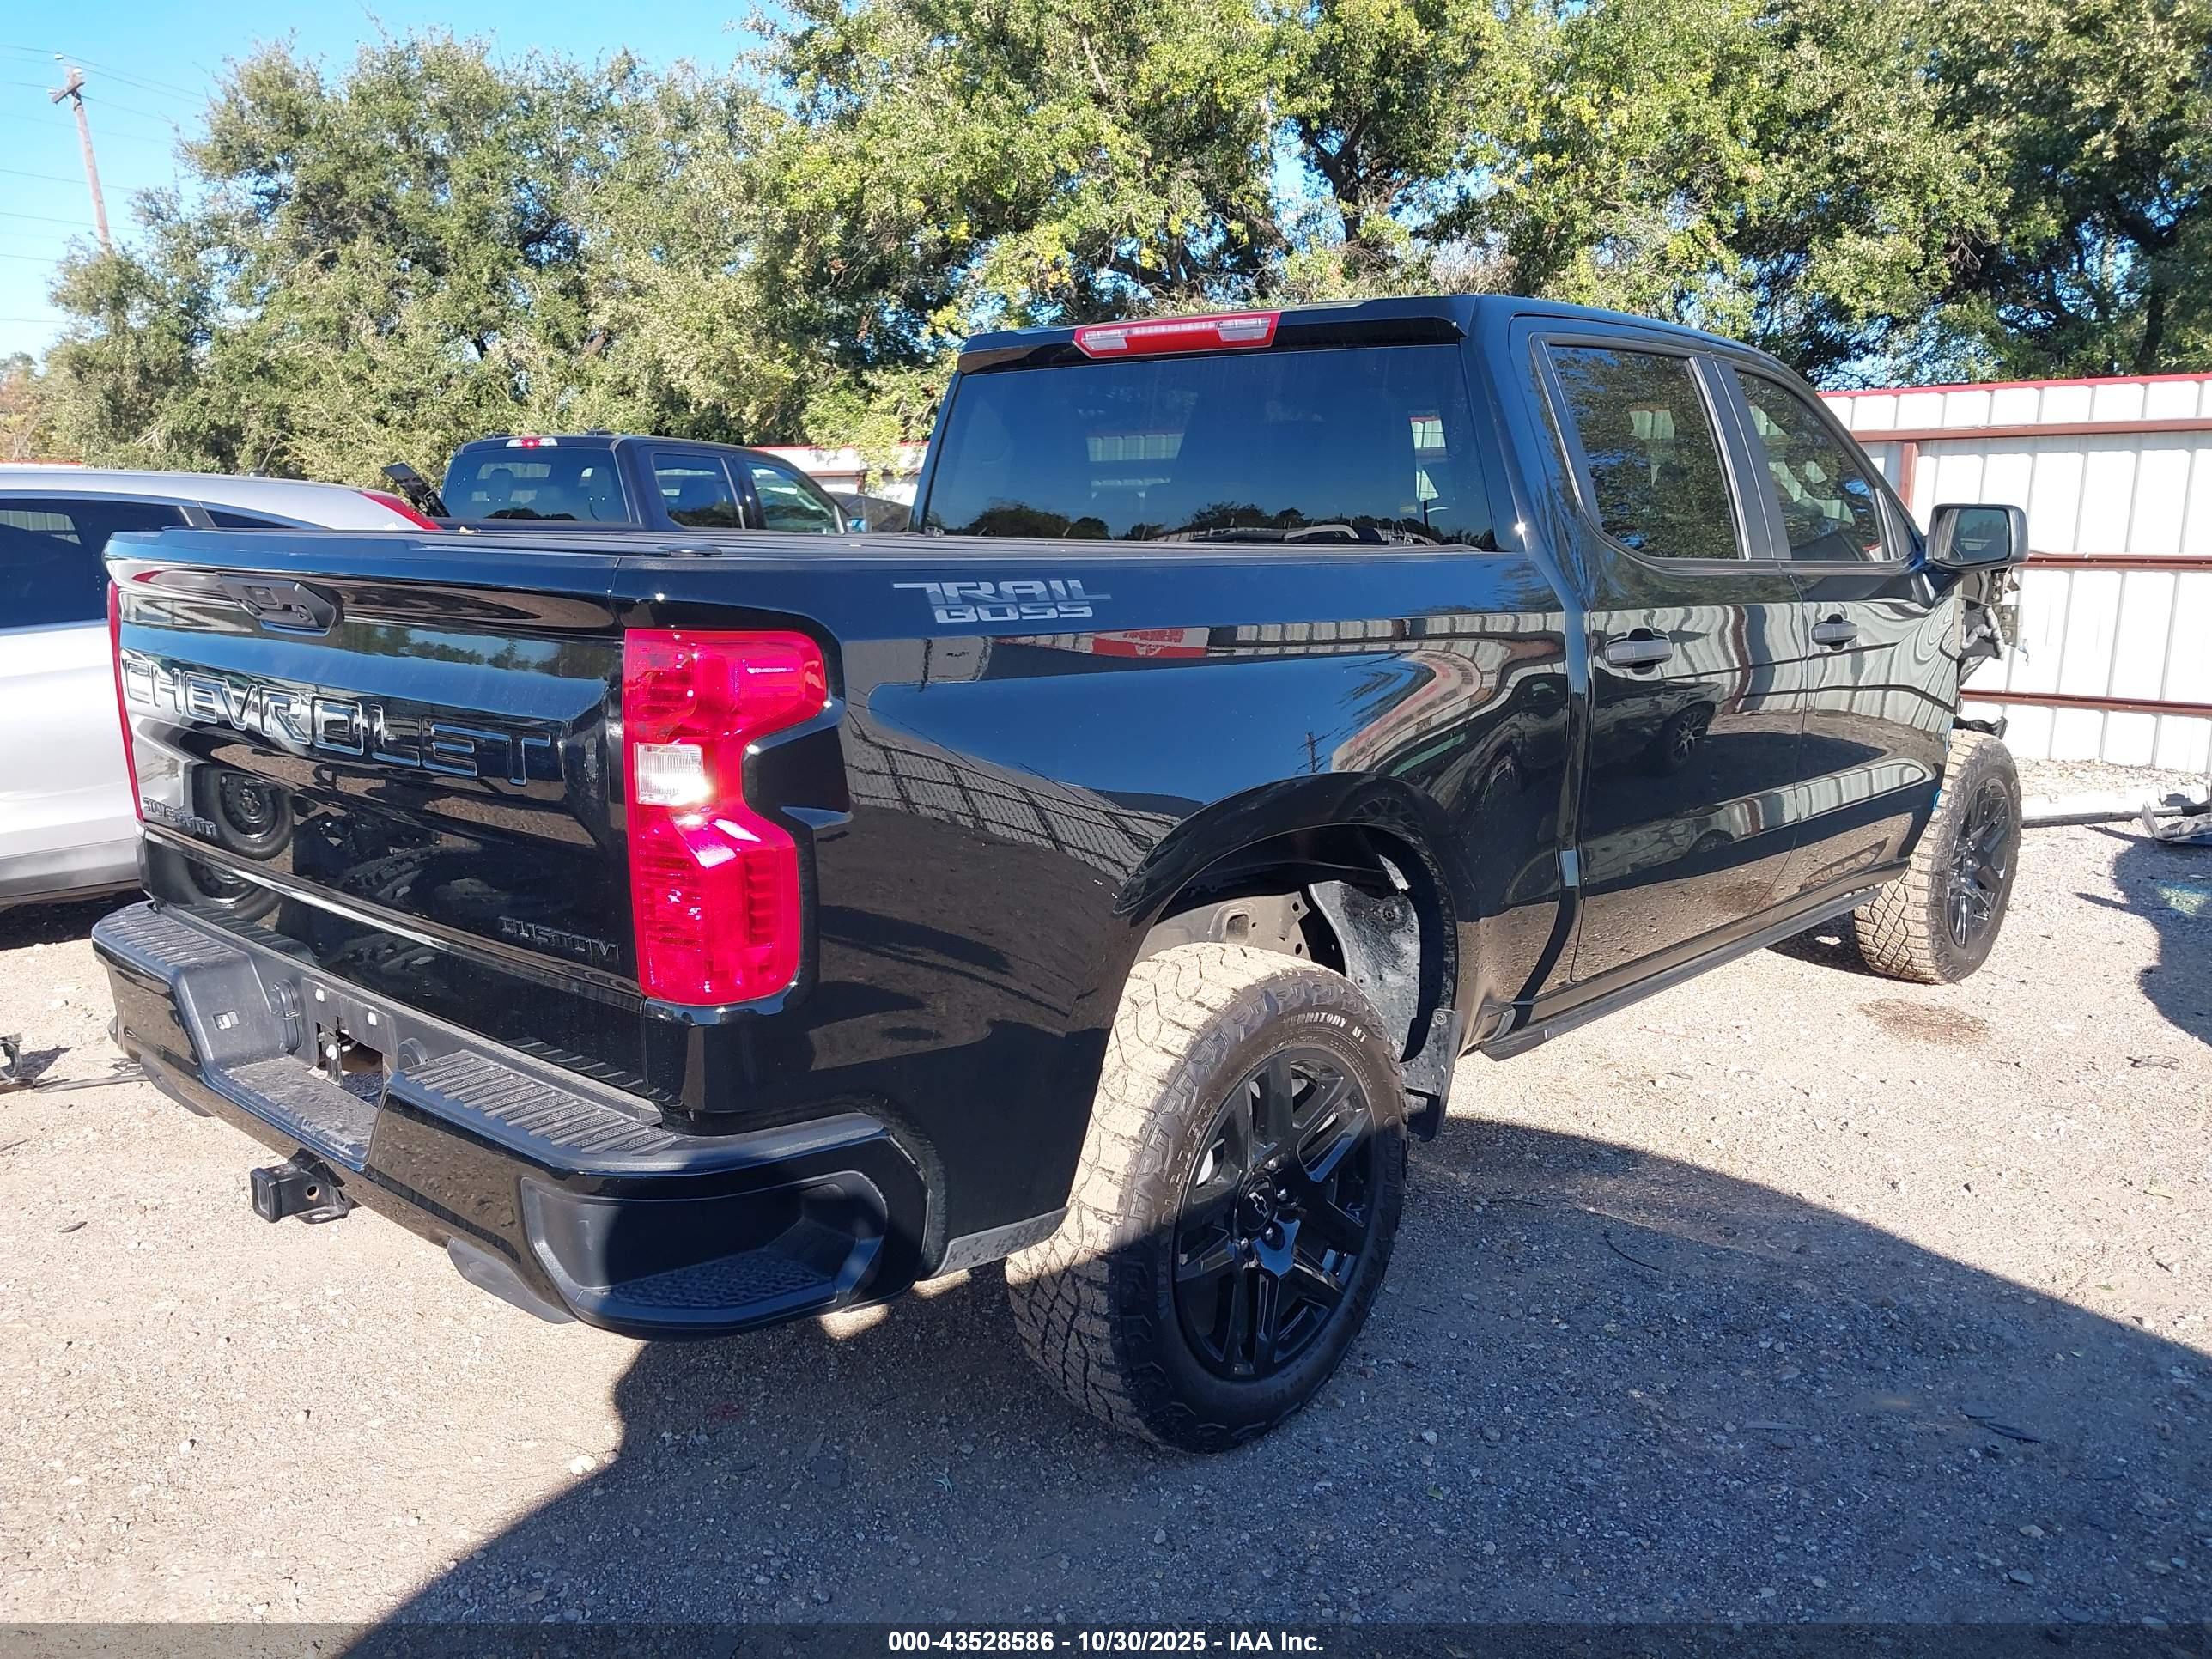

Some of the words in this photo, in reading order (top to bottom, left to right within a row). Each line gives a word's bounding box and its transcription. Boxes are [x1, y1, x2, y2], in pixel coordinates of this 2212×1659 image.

[893, 580, 1112, 605] TRAIL
[933, 601, 1093, 624] BOSS
[125, 656, 551, 786] CHEVROLET
[497, 915, 620, 963] CUSTOM
